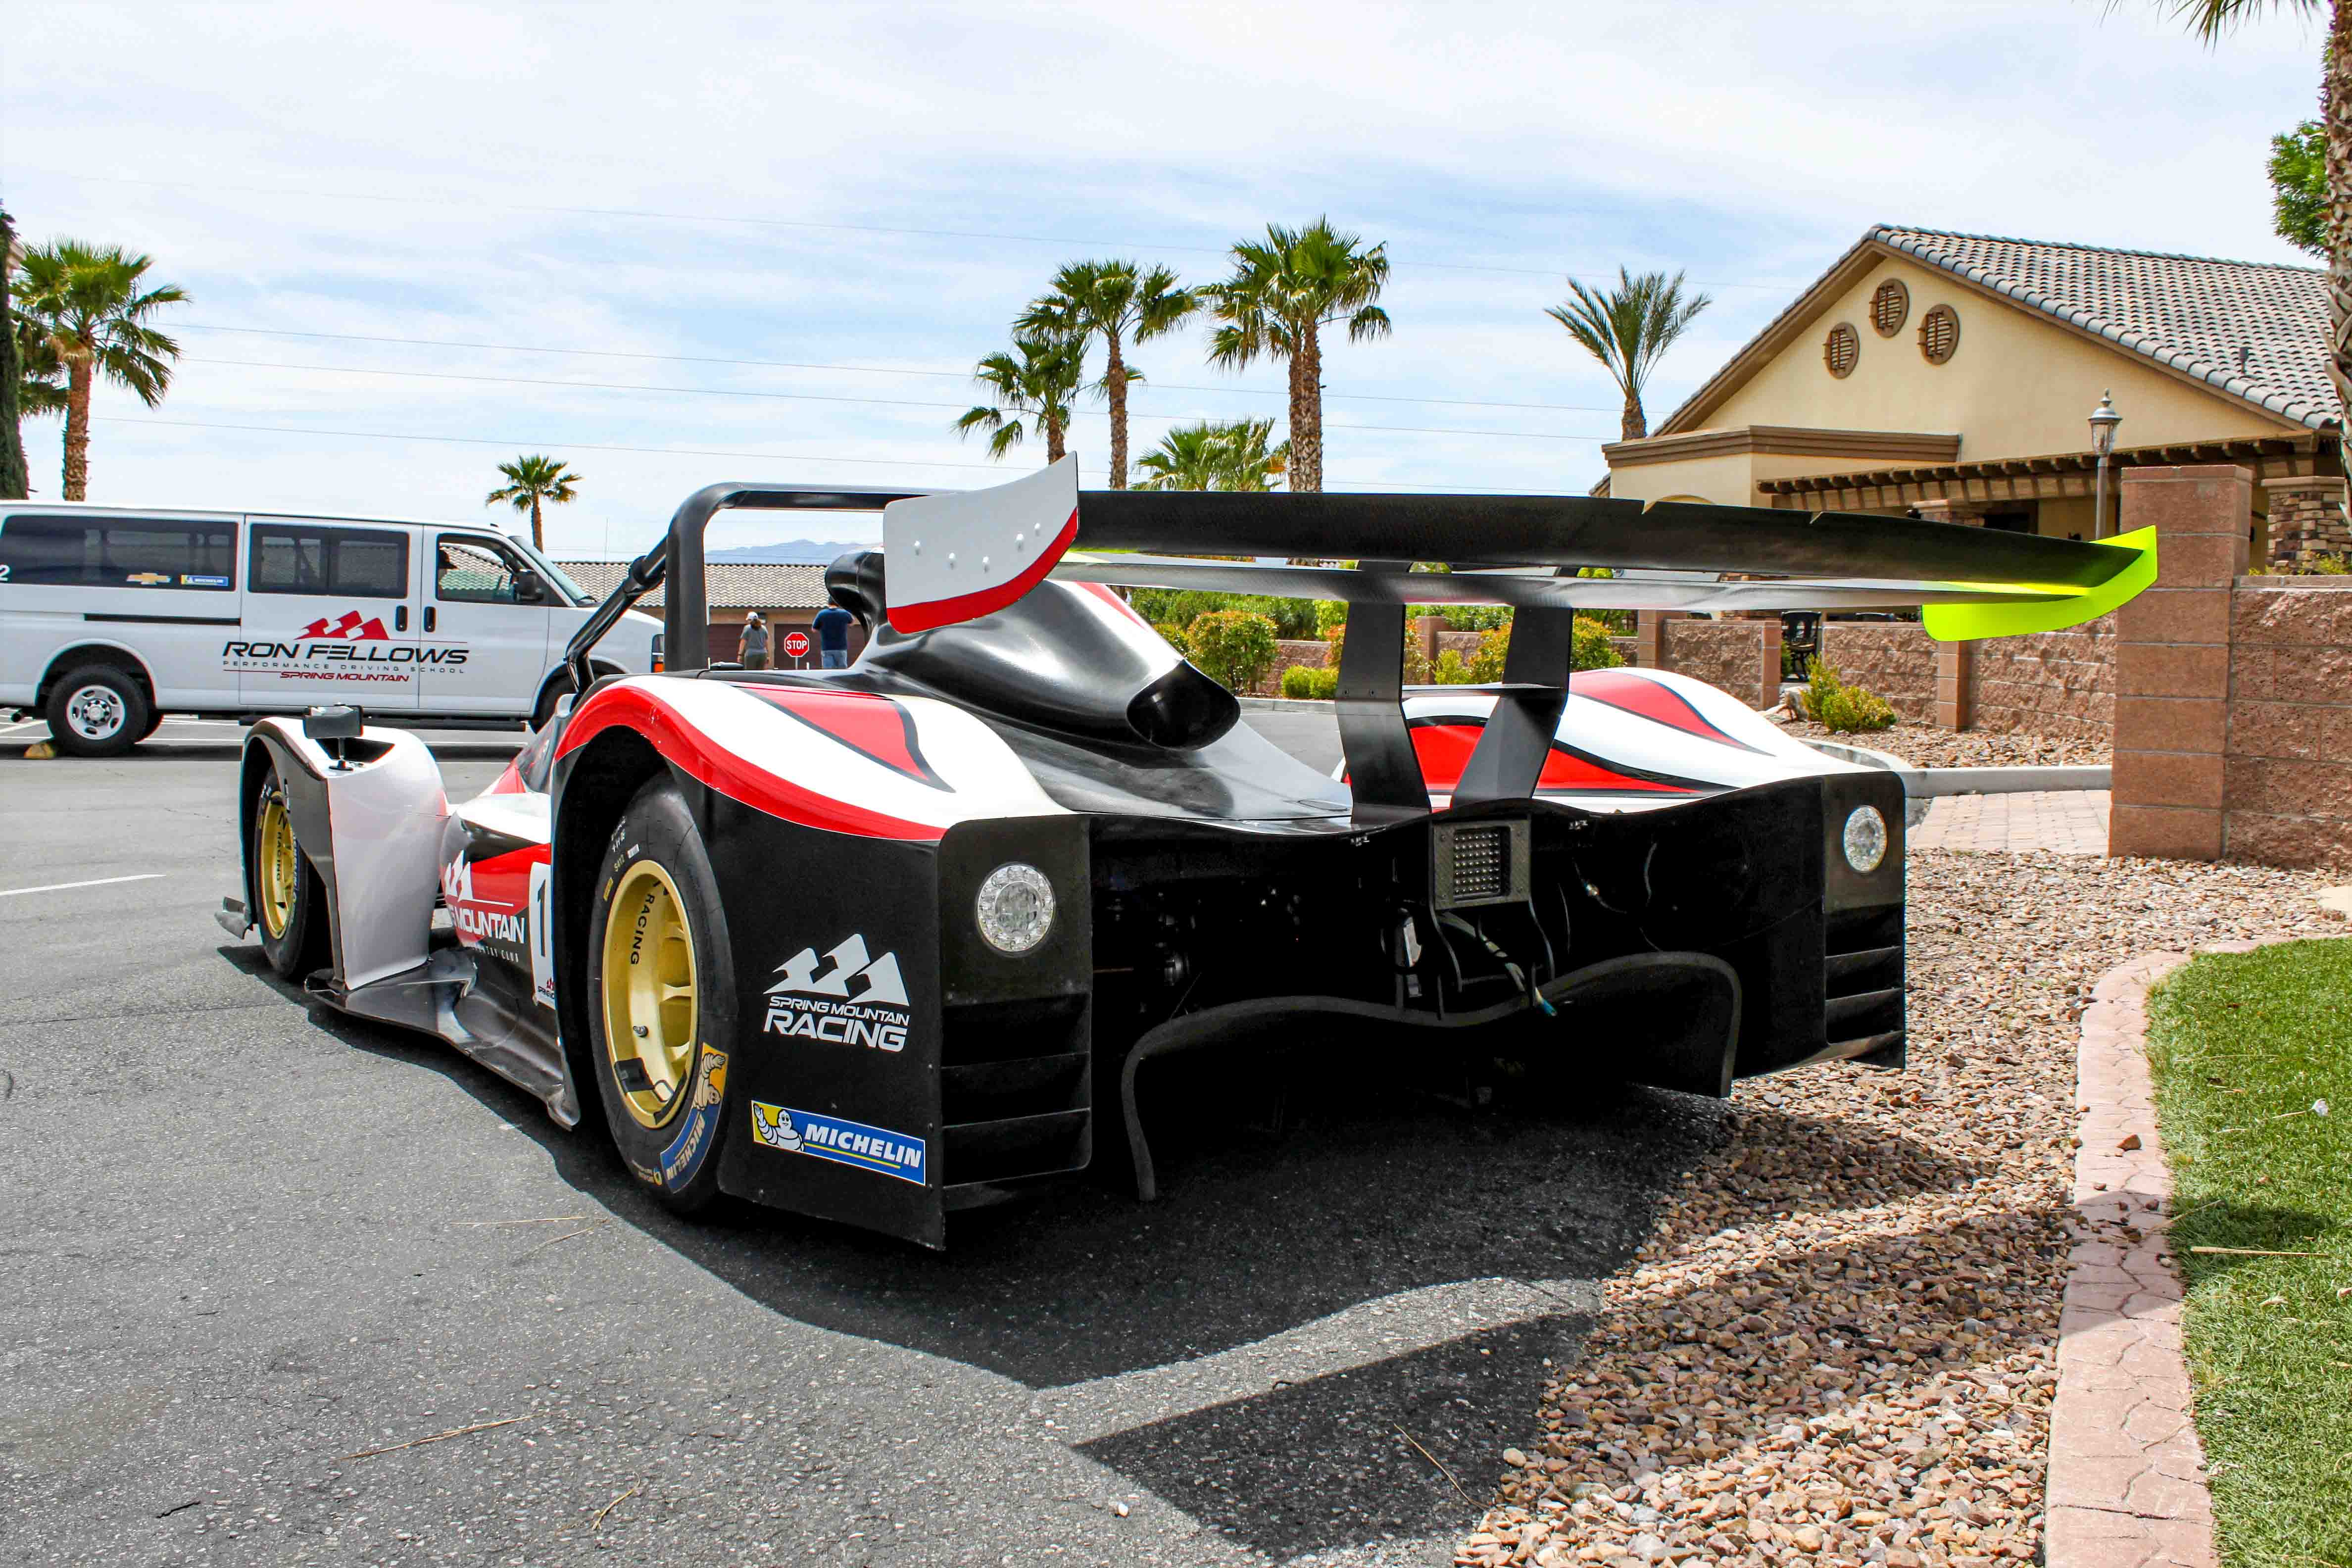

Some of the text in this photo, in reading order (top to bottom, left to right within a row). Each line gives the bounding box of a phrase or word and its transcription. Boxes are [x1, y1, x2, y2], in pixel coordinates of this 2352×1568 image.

[223, 641, 469, 664] RON FELLOWS
[786, 640, 807, 650] STOP
[337, 673, 410, 682] MOUNTAIN
[454, 907, 525, 944] MOUNTAIN
[538, 879, 546, 958] 1
[631, 893, 655, 965] RACING
[763, 1008, 908, 1053] RACING
[769, 995, 910, 1026] SPRING MOUNTAIN
[666, 1113, 705, 1180] MICHELIN
[804, 1123, 922, 1169] MICHELIN
